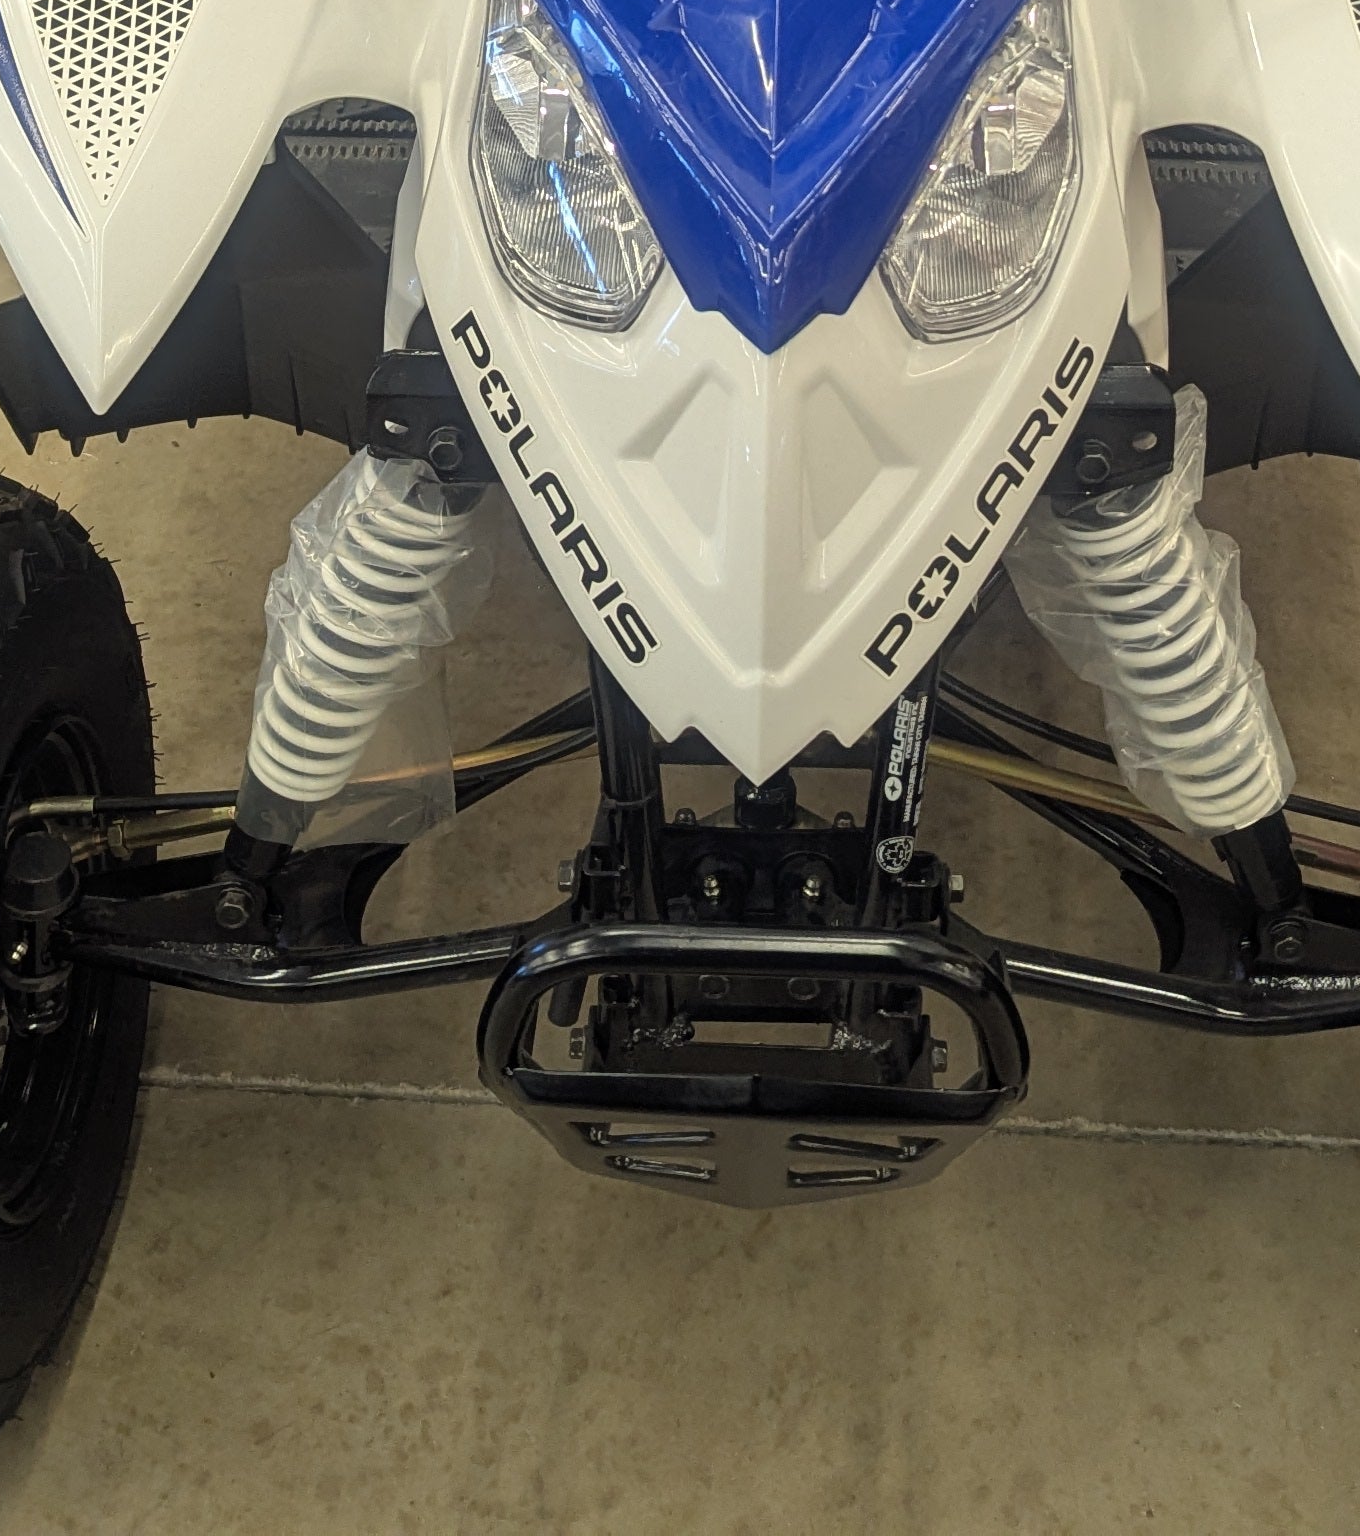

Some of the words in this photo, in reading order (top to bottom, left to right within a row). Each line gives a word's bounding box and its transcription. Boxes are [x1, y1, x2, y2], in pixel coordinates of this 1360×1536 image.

[451, 311, 658, 664] POLARIS
[864, 338, 1094, 674] POLARIS
[888, 695, 910, 777] POLARIS
